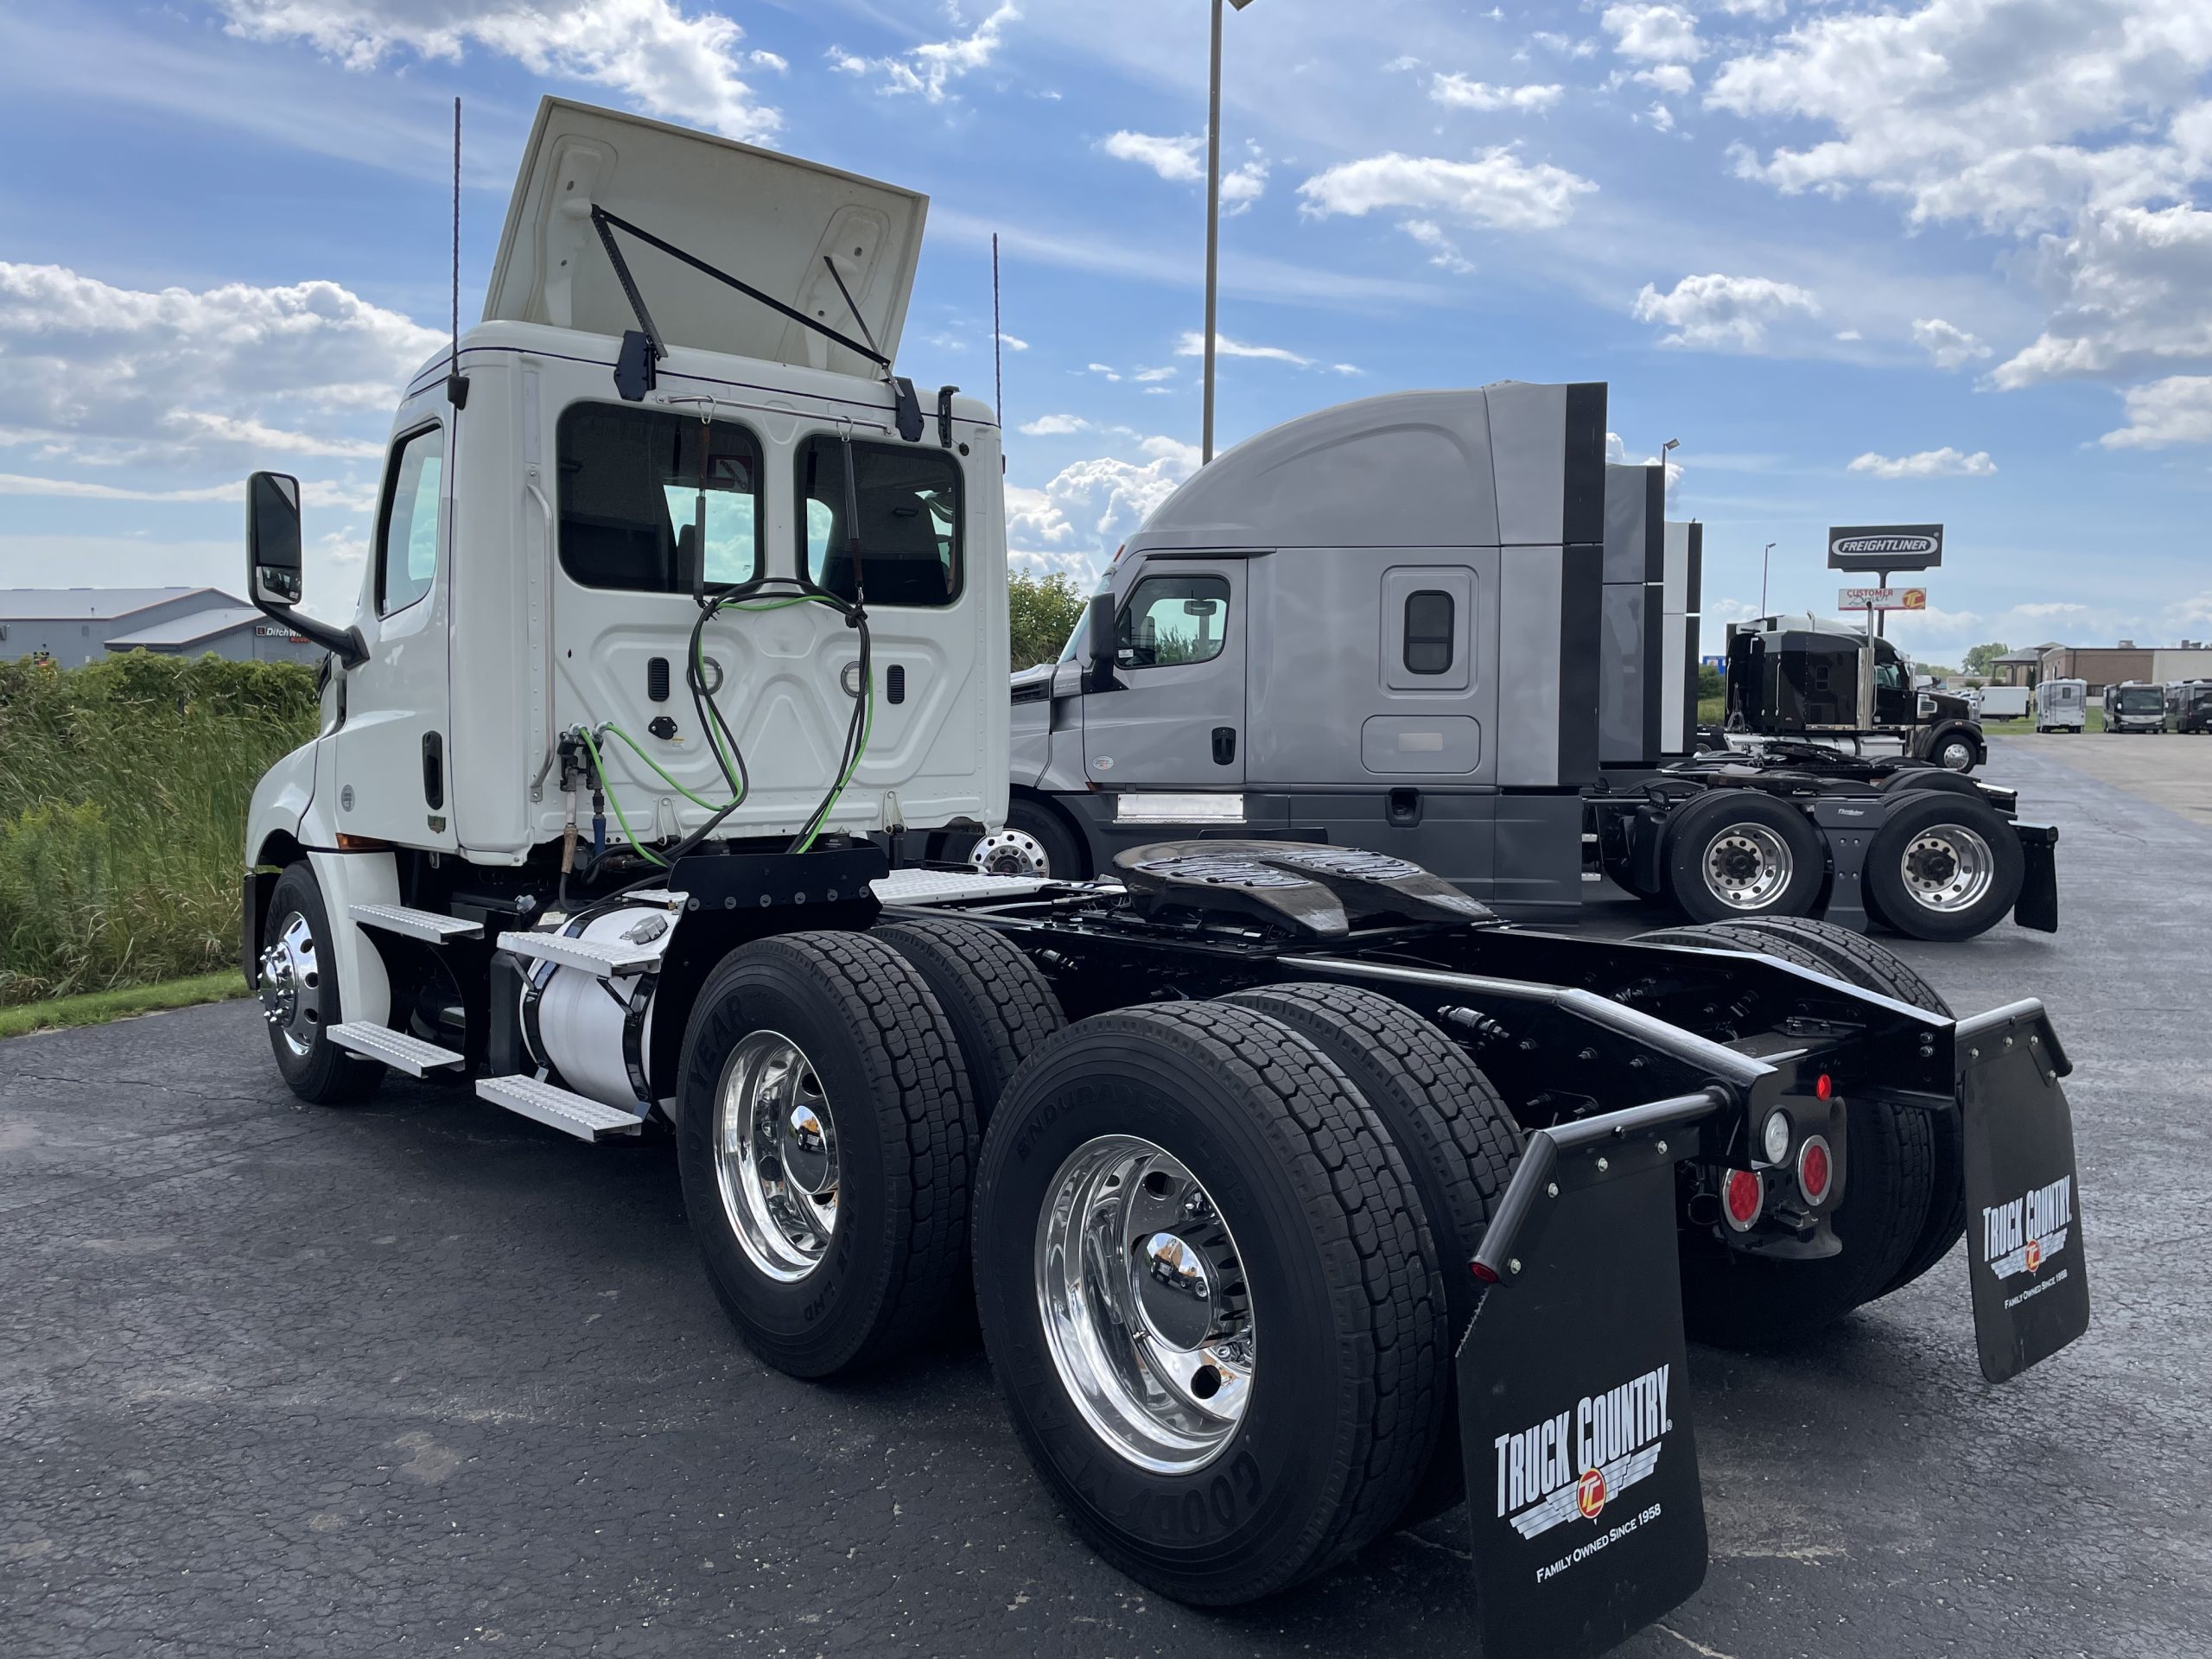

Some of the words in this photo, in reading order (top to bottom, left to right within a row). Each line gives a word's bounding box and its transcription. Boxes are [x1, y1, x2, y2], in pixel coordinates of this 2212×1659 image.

[1842, 540, 1927, 551] FREIGHTLINER
[1015, 1083, 1184, 1162] ENDURANCE
[1983, 1197, 2024, 1262] TRUCK
[2026, 1174, 2070, 1243] COUNTRY
[1495, 1410, 1571, 1518] TRUCK
[1577, 1363, 1669, 1476] COUNTRY
[1536, 1554, 1572, 1583] FAMILY
[1573, 1535, 1609, 1562] OWNED
[1610, 1518, 1637, 1542] SINCE
[1638, 1503, 1662, 1526] 1958
